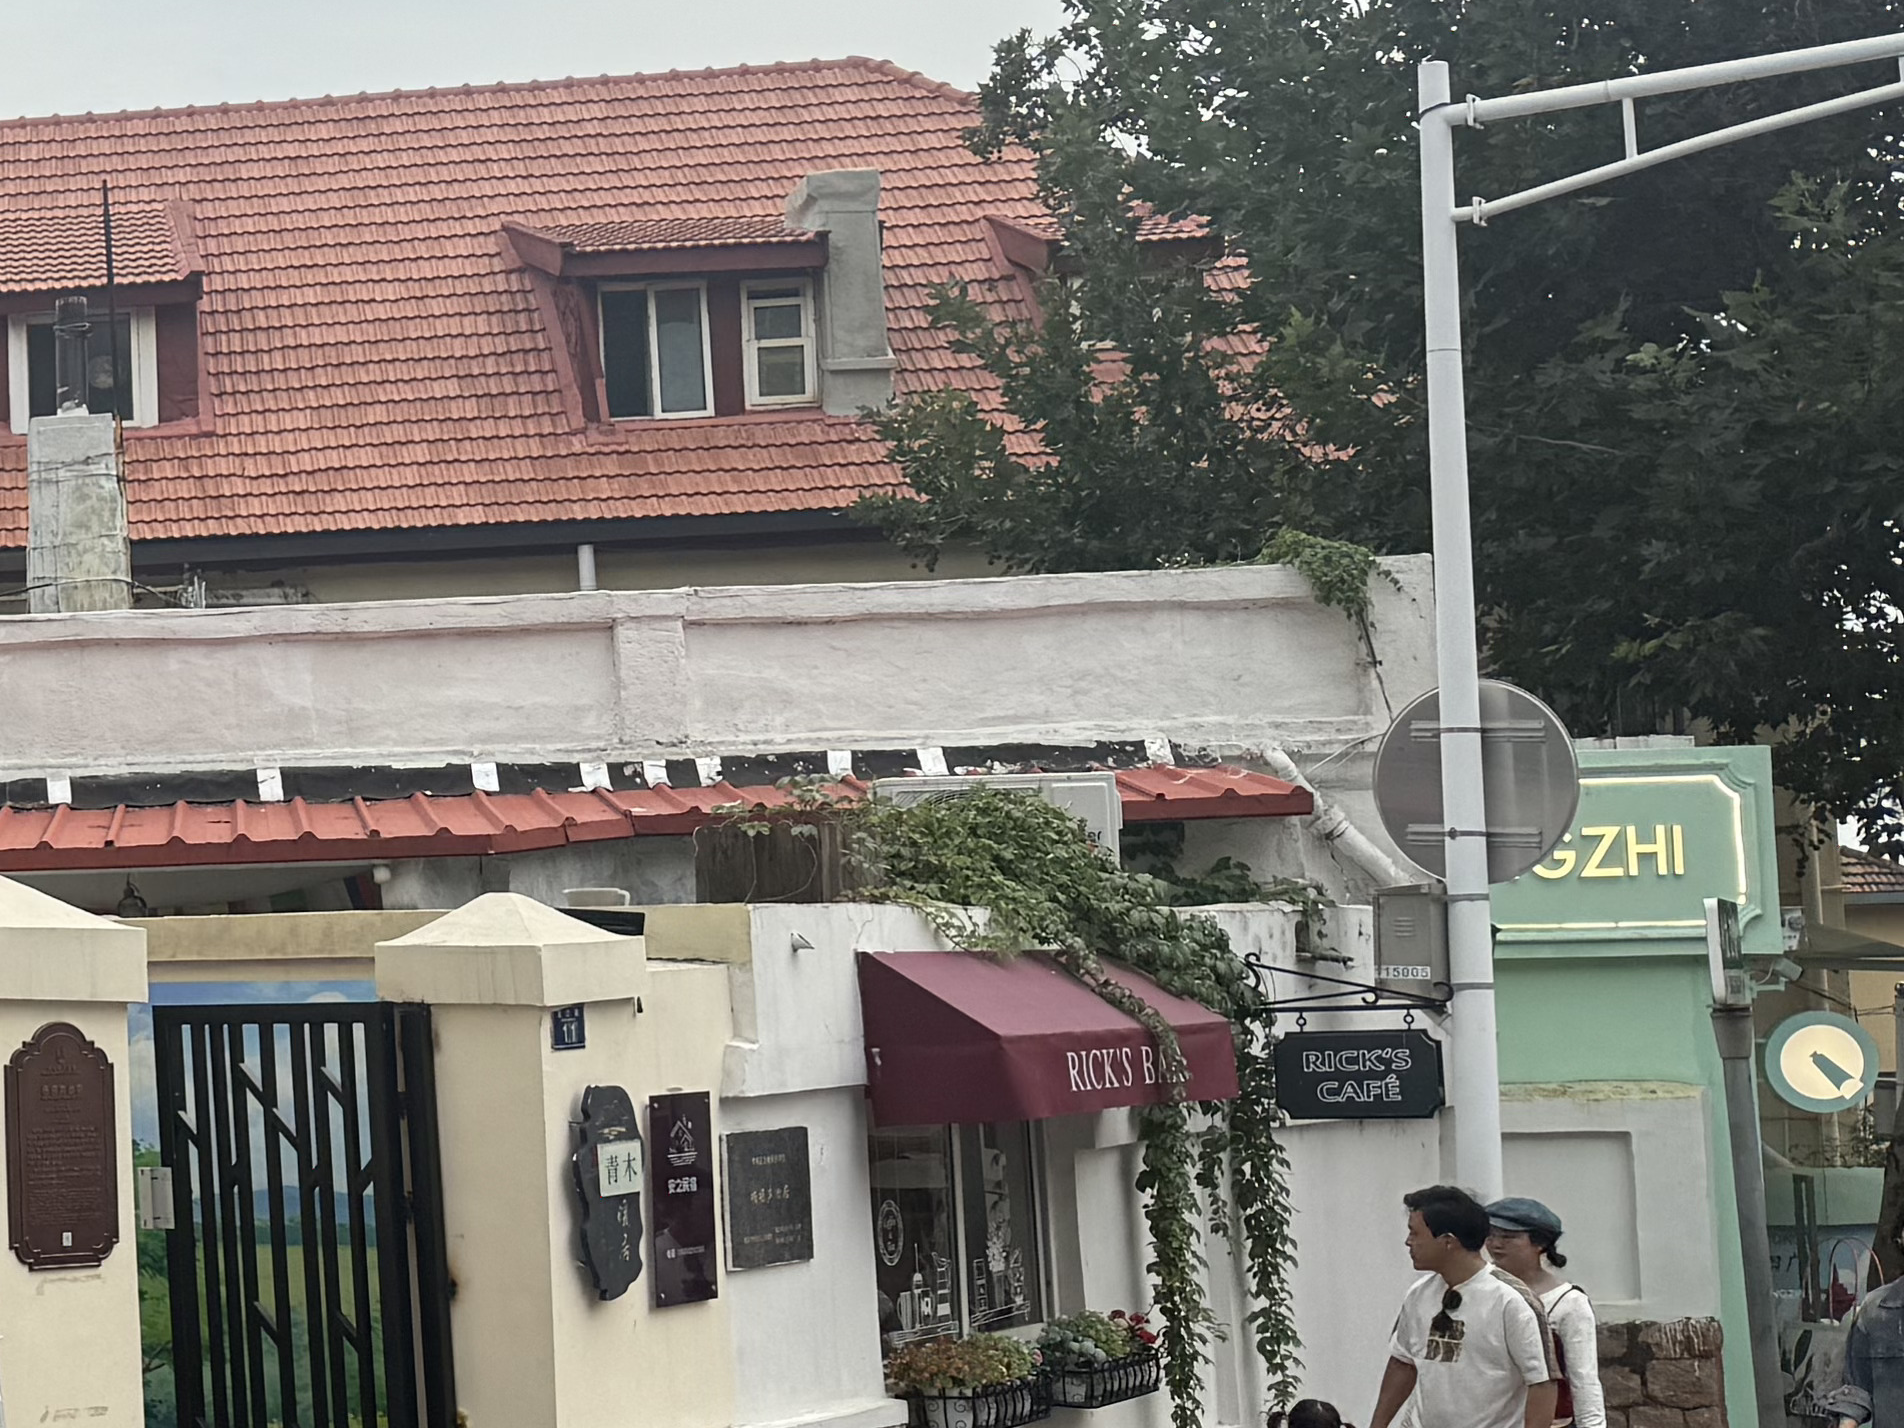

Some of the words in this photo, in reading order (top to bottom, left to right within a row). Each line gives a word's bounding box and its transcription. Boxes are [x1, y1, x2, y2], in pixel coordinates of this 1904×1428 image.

[1066, 1047, 1133, 1093] RICK'S
[1302, 1048, 1413, 1073] RICK'S
[1316, 1073, 1403, 1103] CAFÉ
